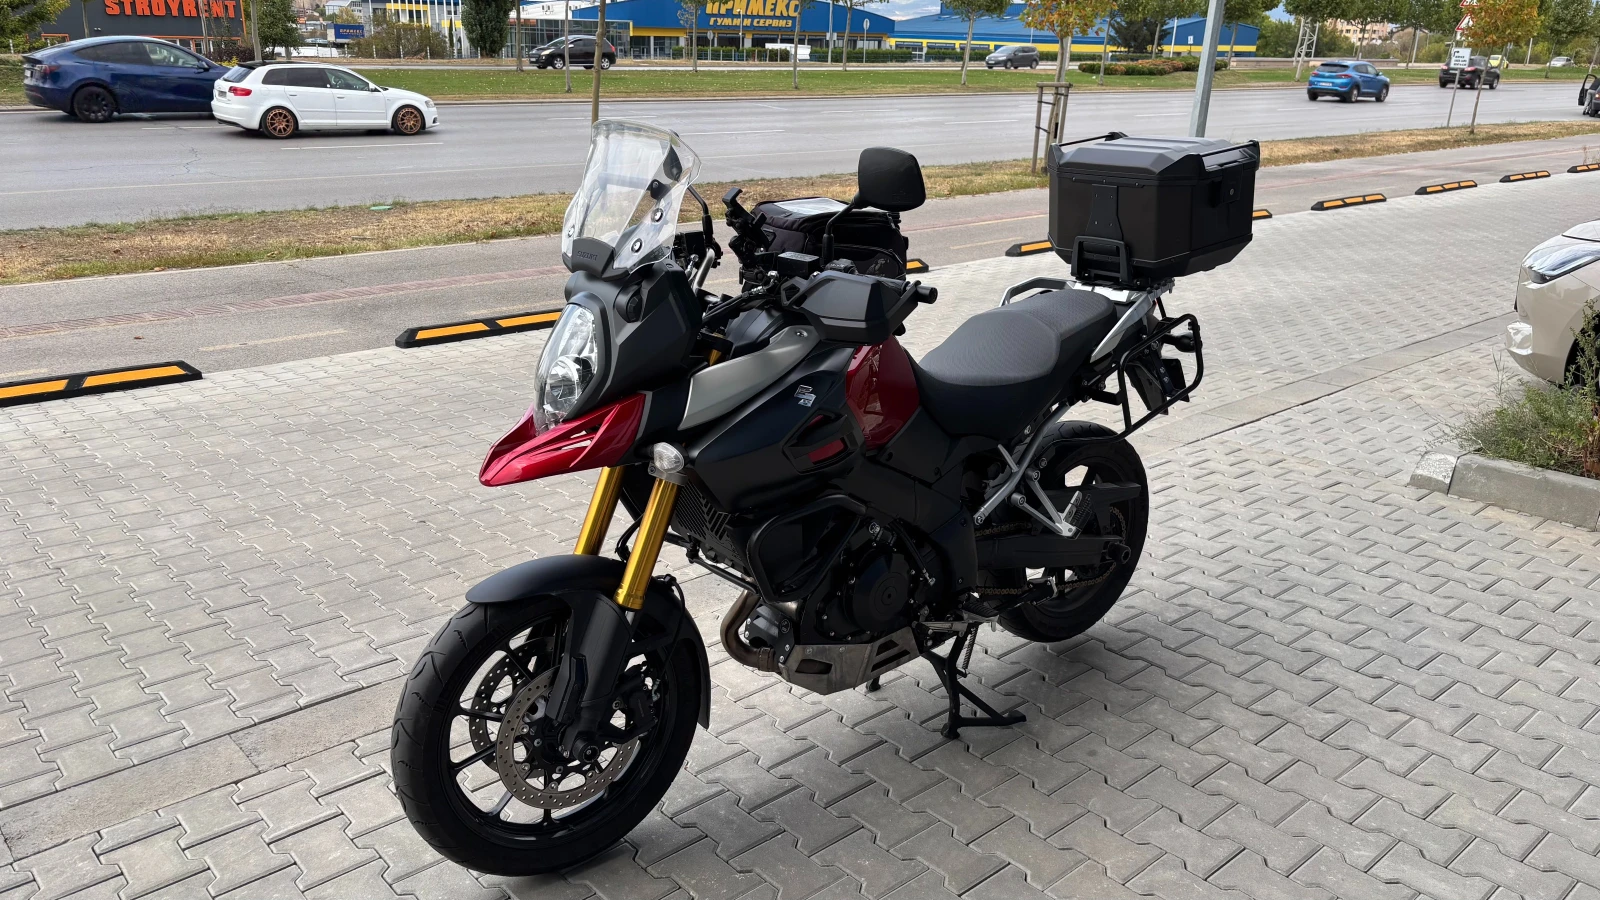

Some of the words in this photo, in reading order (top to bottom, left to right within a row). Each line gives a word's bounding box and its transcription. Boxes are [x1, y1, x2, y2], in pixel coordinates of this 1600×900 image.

[709, 17, 741, 26] ГУМИ
[743, 18, 751, 27] И
[753, 19, 792, 27] СЕРВИЗ
